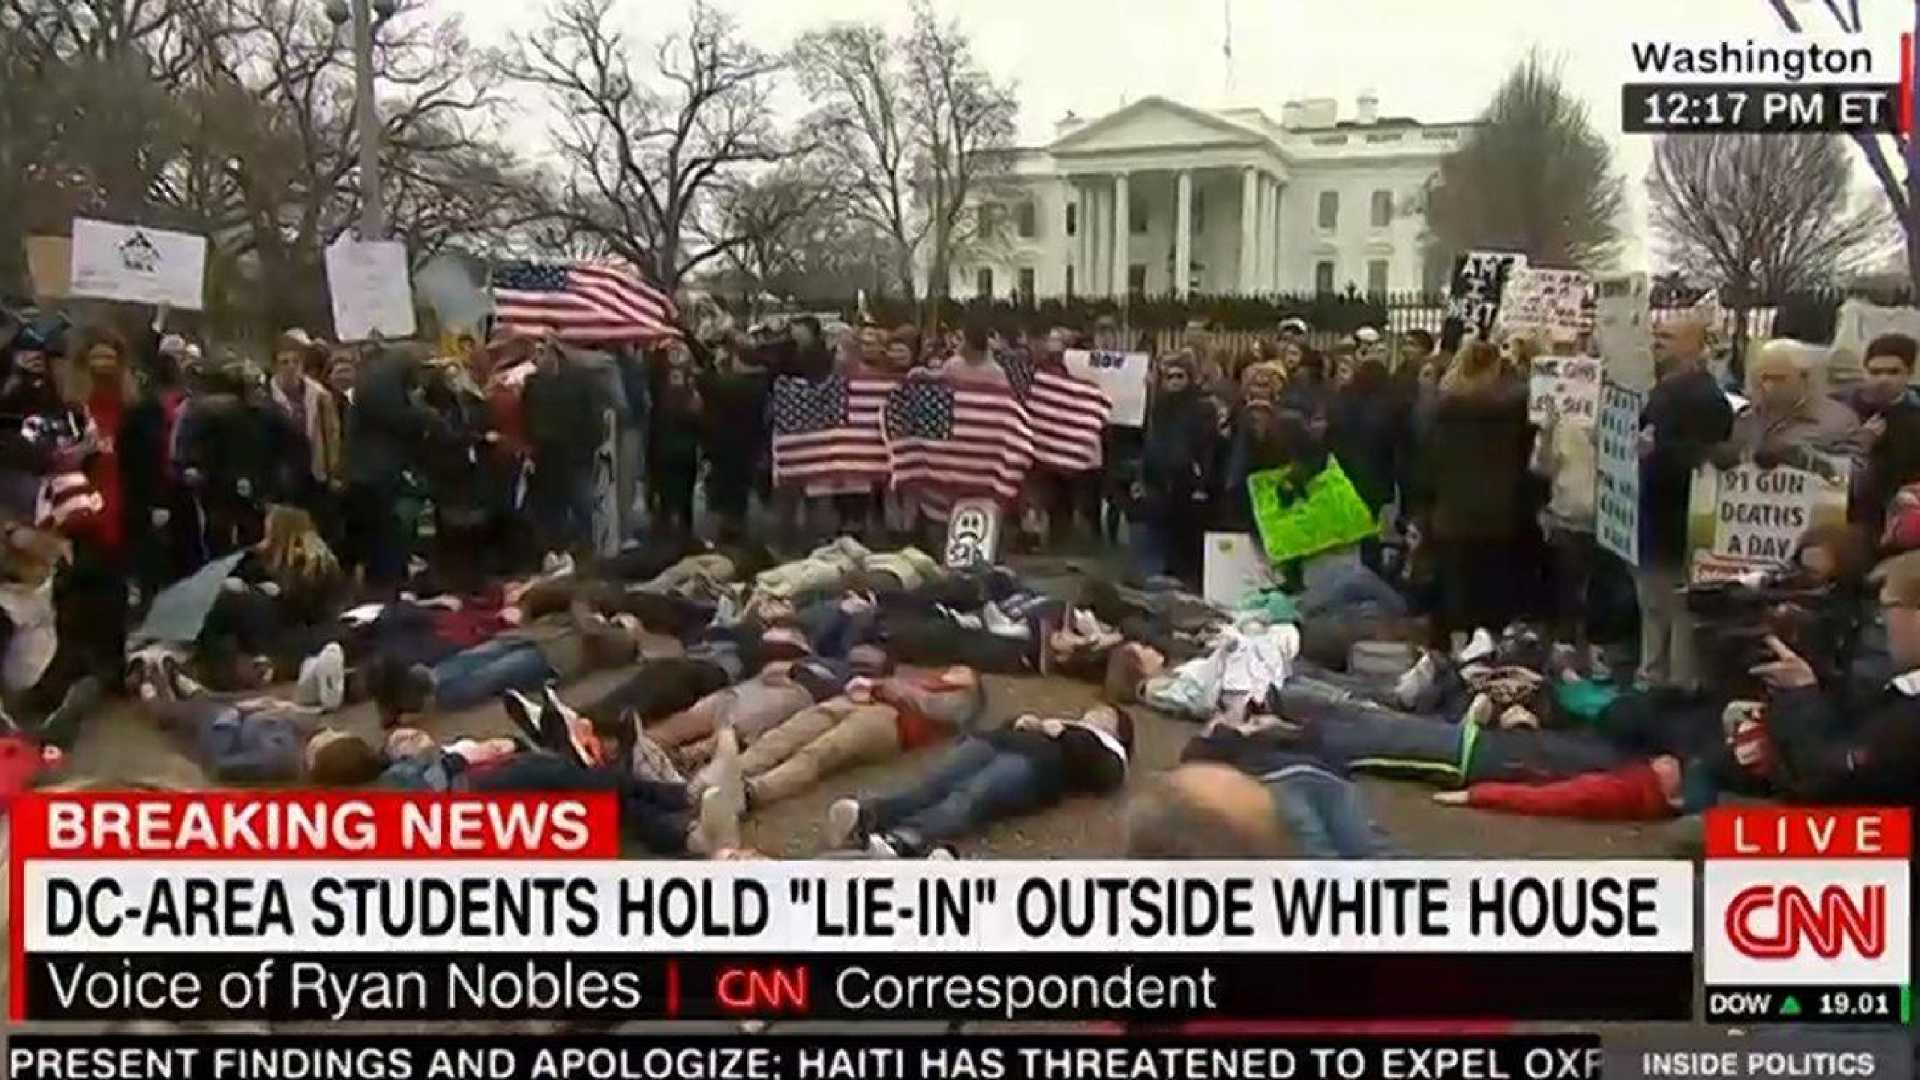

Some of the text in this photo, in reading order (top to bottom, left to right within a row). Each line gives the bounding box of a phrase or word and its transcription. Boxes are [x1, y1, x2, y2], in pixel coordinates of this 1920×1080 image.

[1724, 471, 1805, 494] 91 GUN
[1720, 501, 1804, 527] DEATHS
[1727, 533, 1791, 560] A DAY
